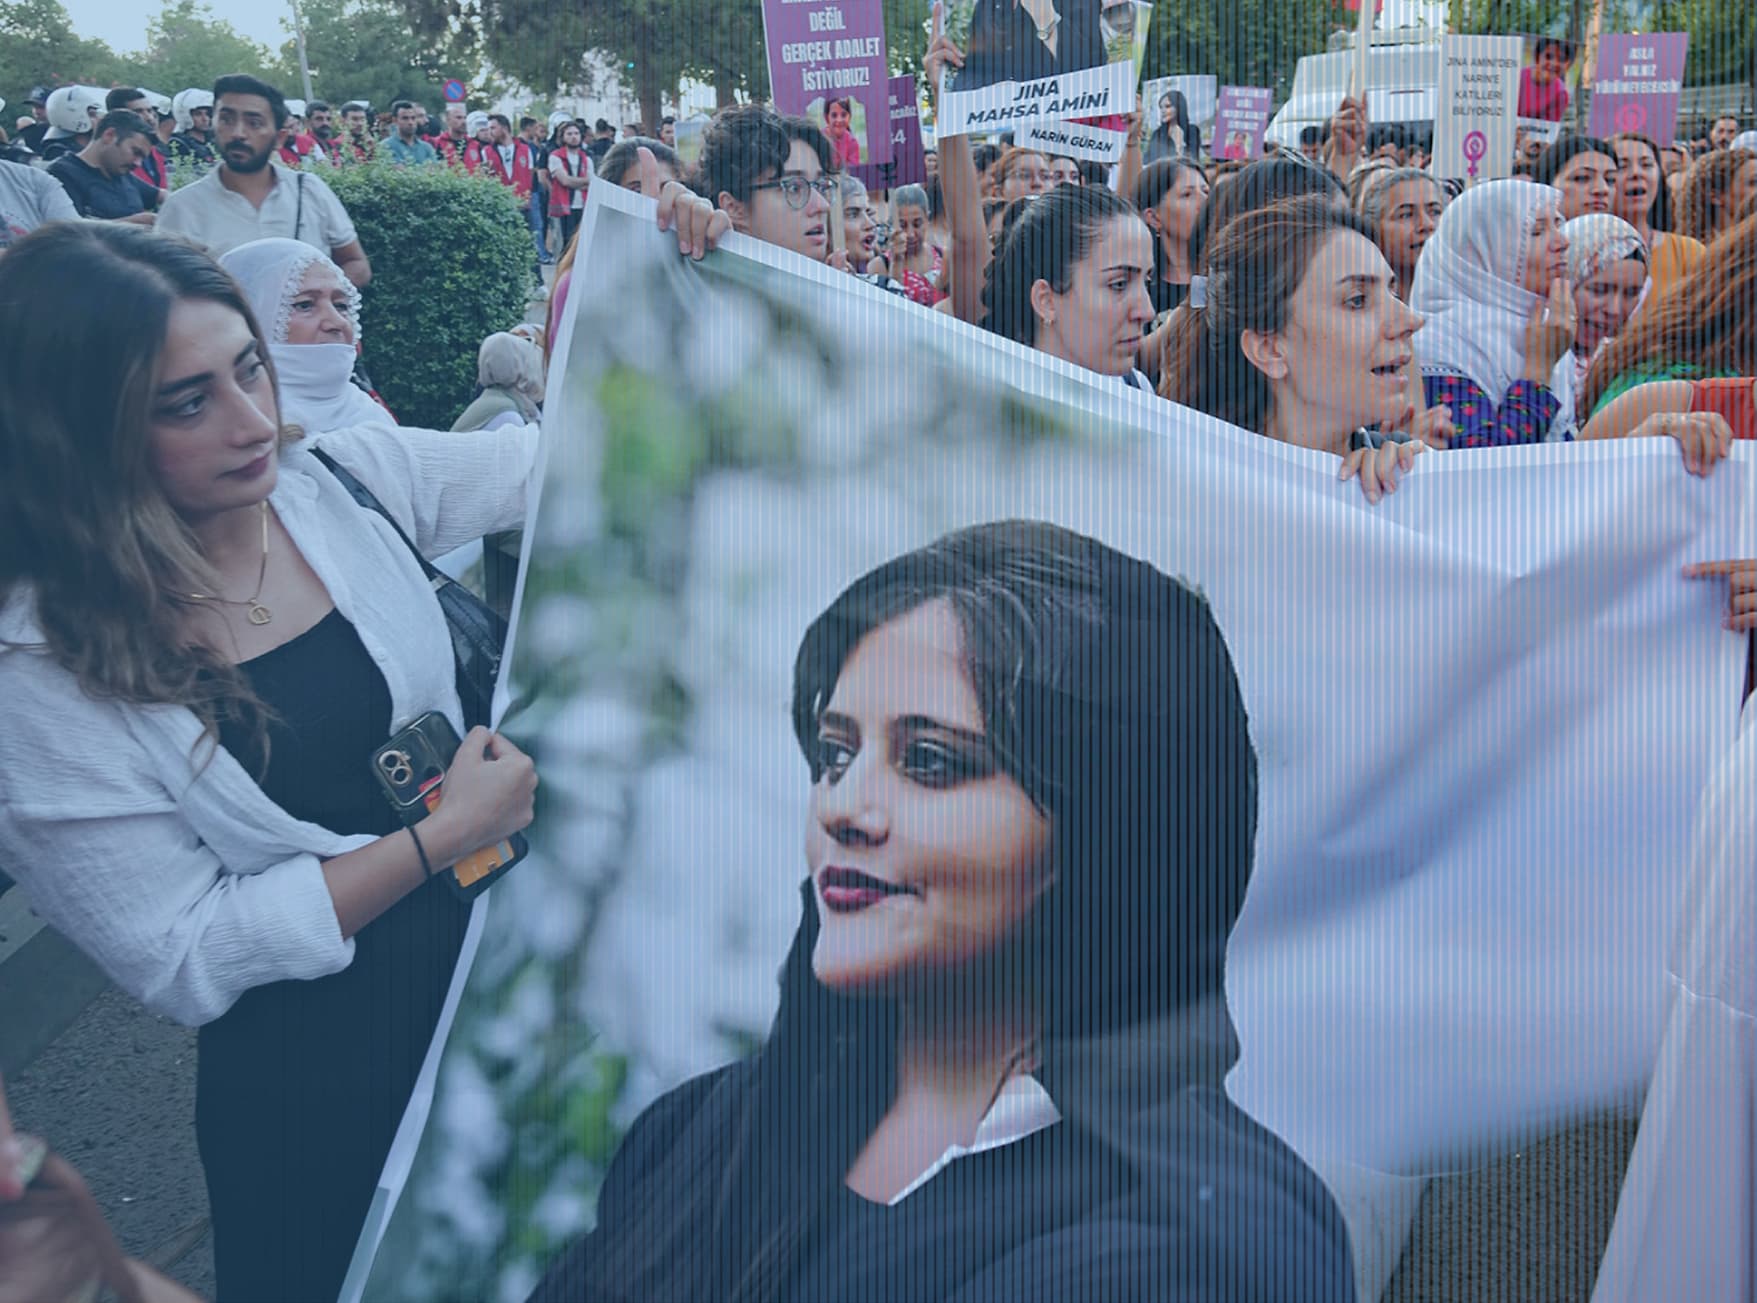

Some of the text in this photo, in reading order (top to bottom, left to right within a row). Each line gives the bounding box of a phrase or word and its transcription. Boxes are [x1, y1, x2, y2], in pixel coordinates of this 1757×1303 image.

[809, 7, 846, 32] DEĞİL
[782, 37, 880, 67] GERÇEK ADALET
[802, 67, 870, 91] İSTİYORUZ!
[1013, 80, 1059, 101] JINA
[966, 88, 1109, 125] MAHSA AMİNİ
[1030, 128, 1113, 152] NARİN GÜRAN
